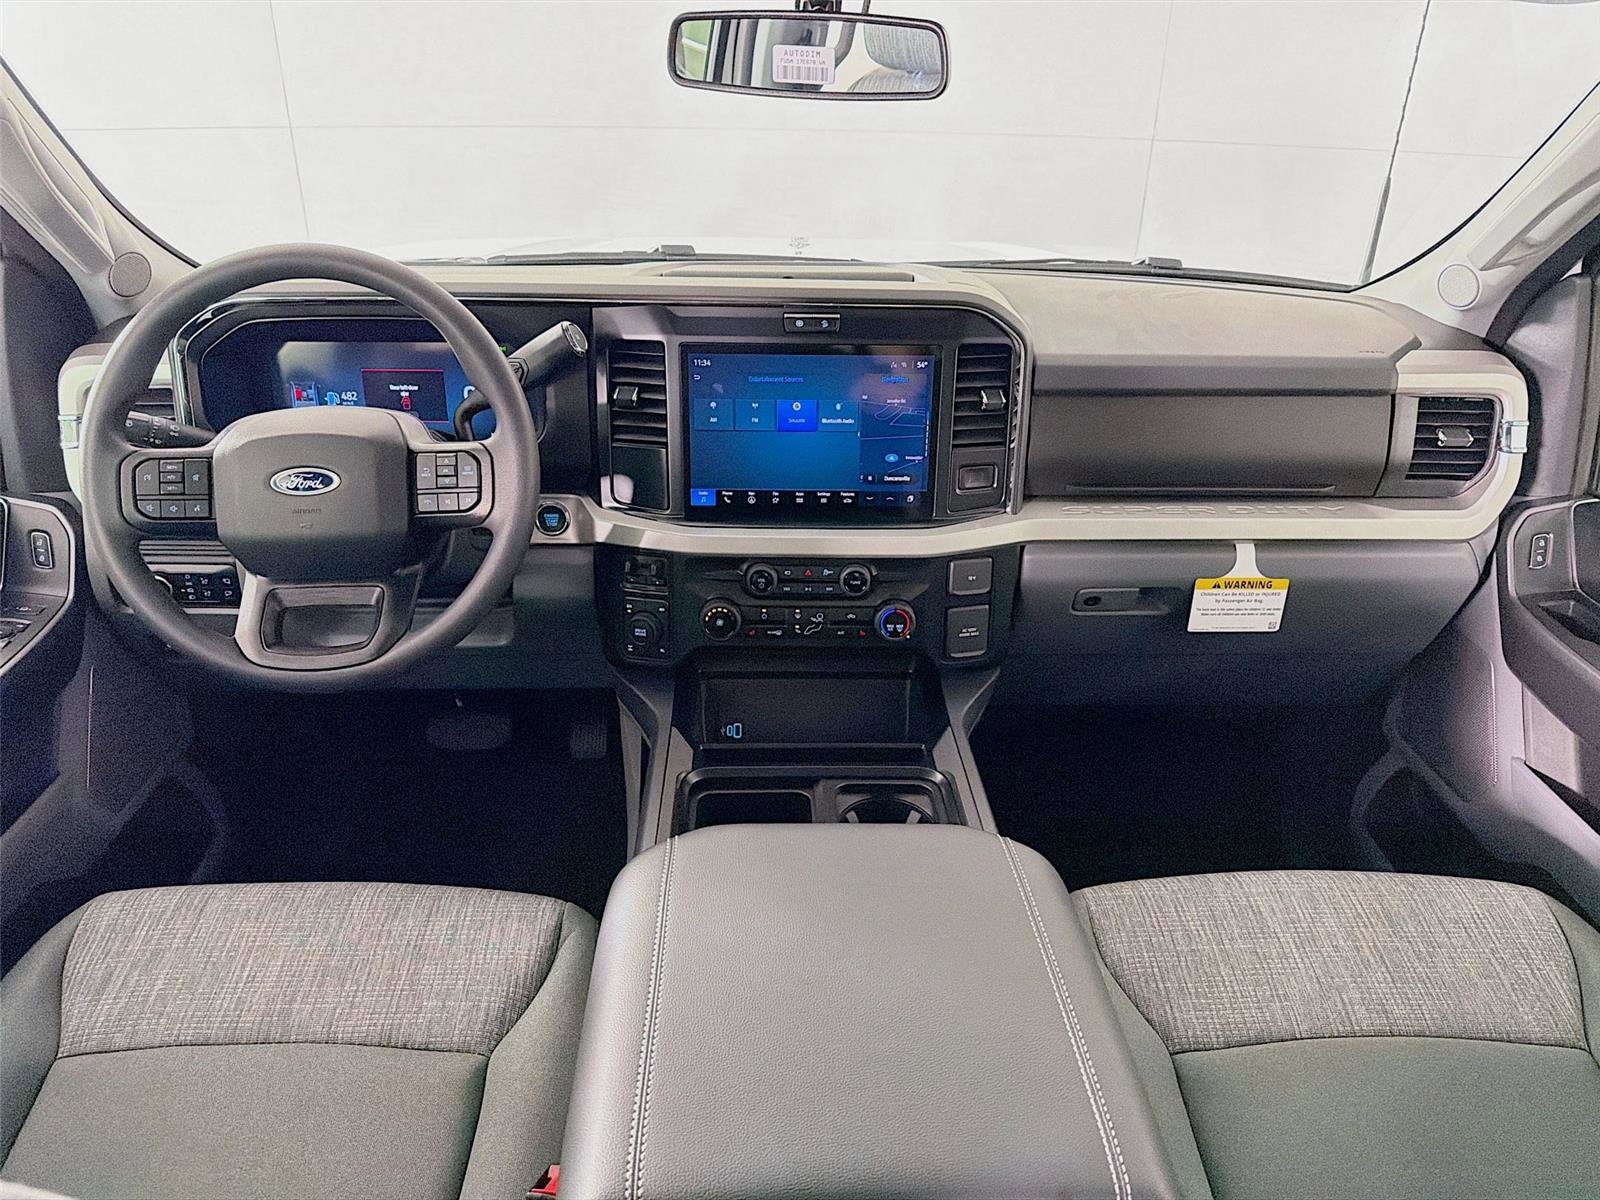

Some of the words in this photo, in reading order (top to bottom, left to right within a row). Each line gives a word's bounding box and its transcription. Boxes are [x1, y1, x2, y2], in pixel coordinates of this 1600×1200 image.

[783, 49, 821, 58] AUTODIM
[693, 359, 711, 367] 11:34
[341, 391, 358, 401] 482
[280, 473, 325, 489] Ford
[1224, 580, 1273, 589] WARNING
